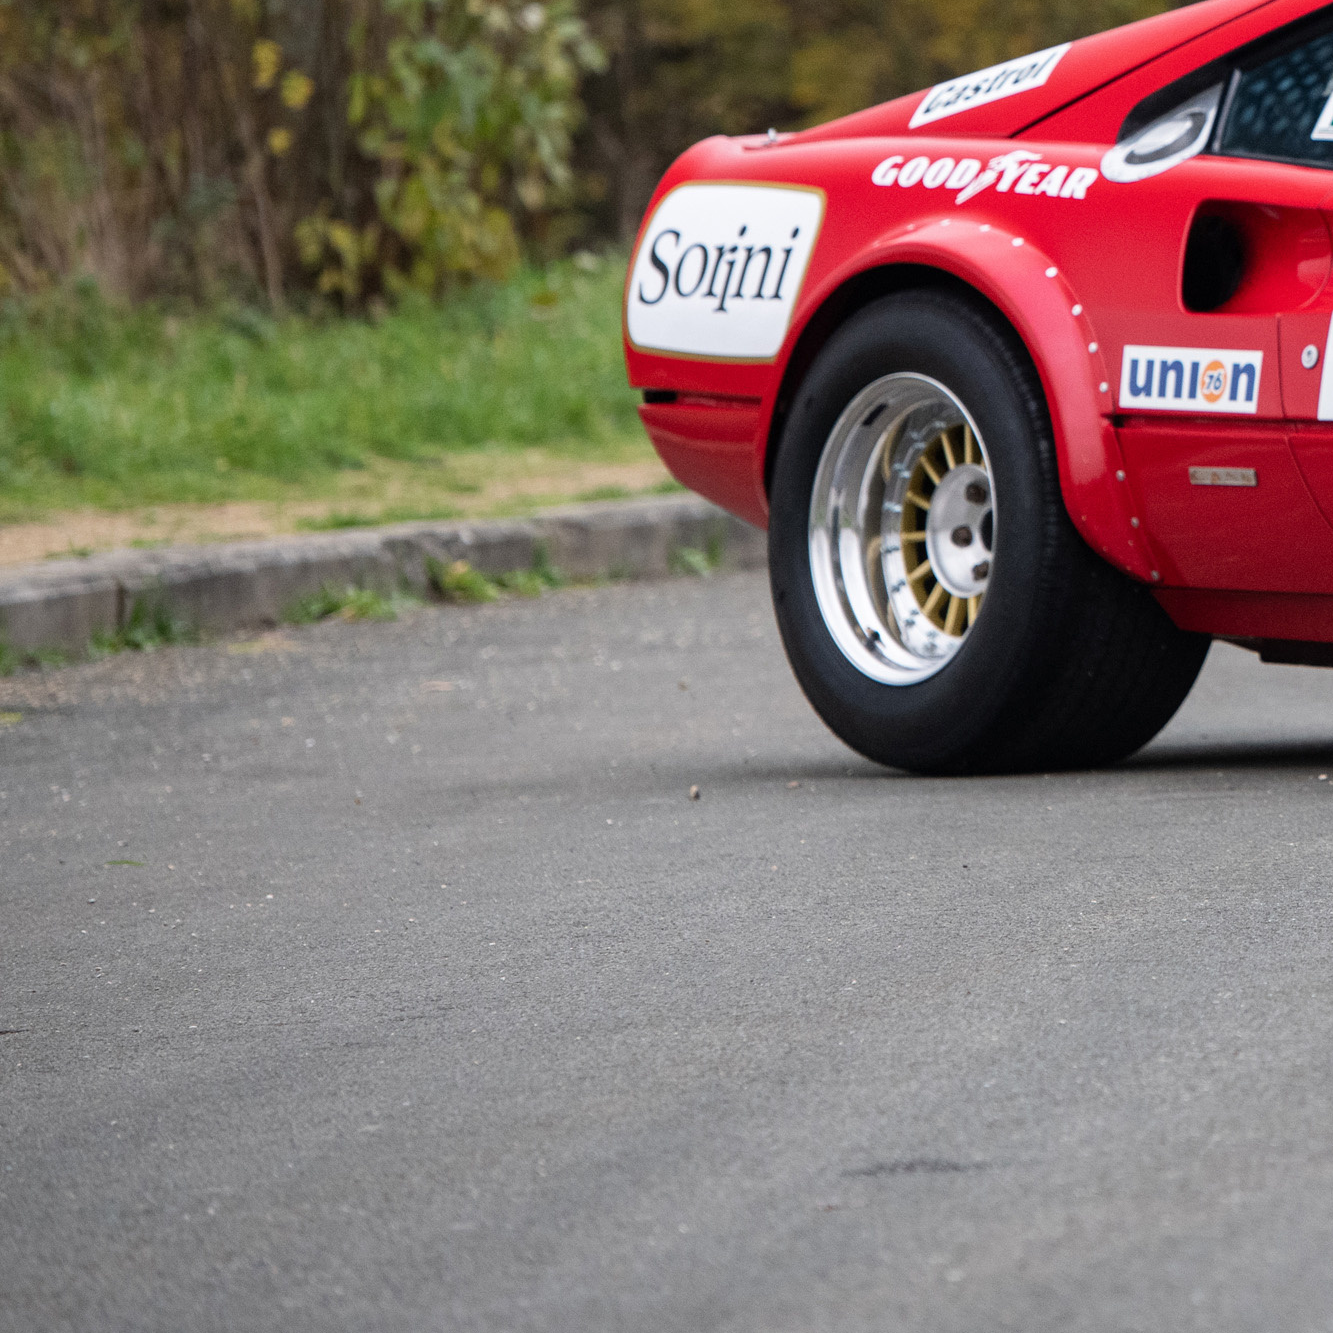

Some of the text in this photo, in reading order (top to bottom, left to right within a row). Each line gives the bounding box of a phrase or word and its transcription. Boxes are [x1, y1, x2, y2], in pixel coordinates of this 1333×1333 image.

[923, 51, 1058, 114] Castrol
[871, 150, 1099, 205] GOODYEAR
[638, 224, 801, 313] Sorini
[1129, 358, 1256, 403] union
